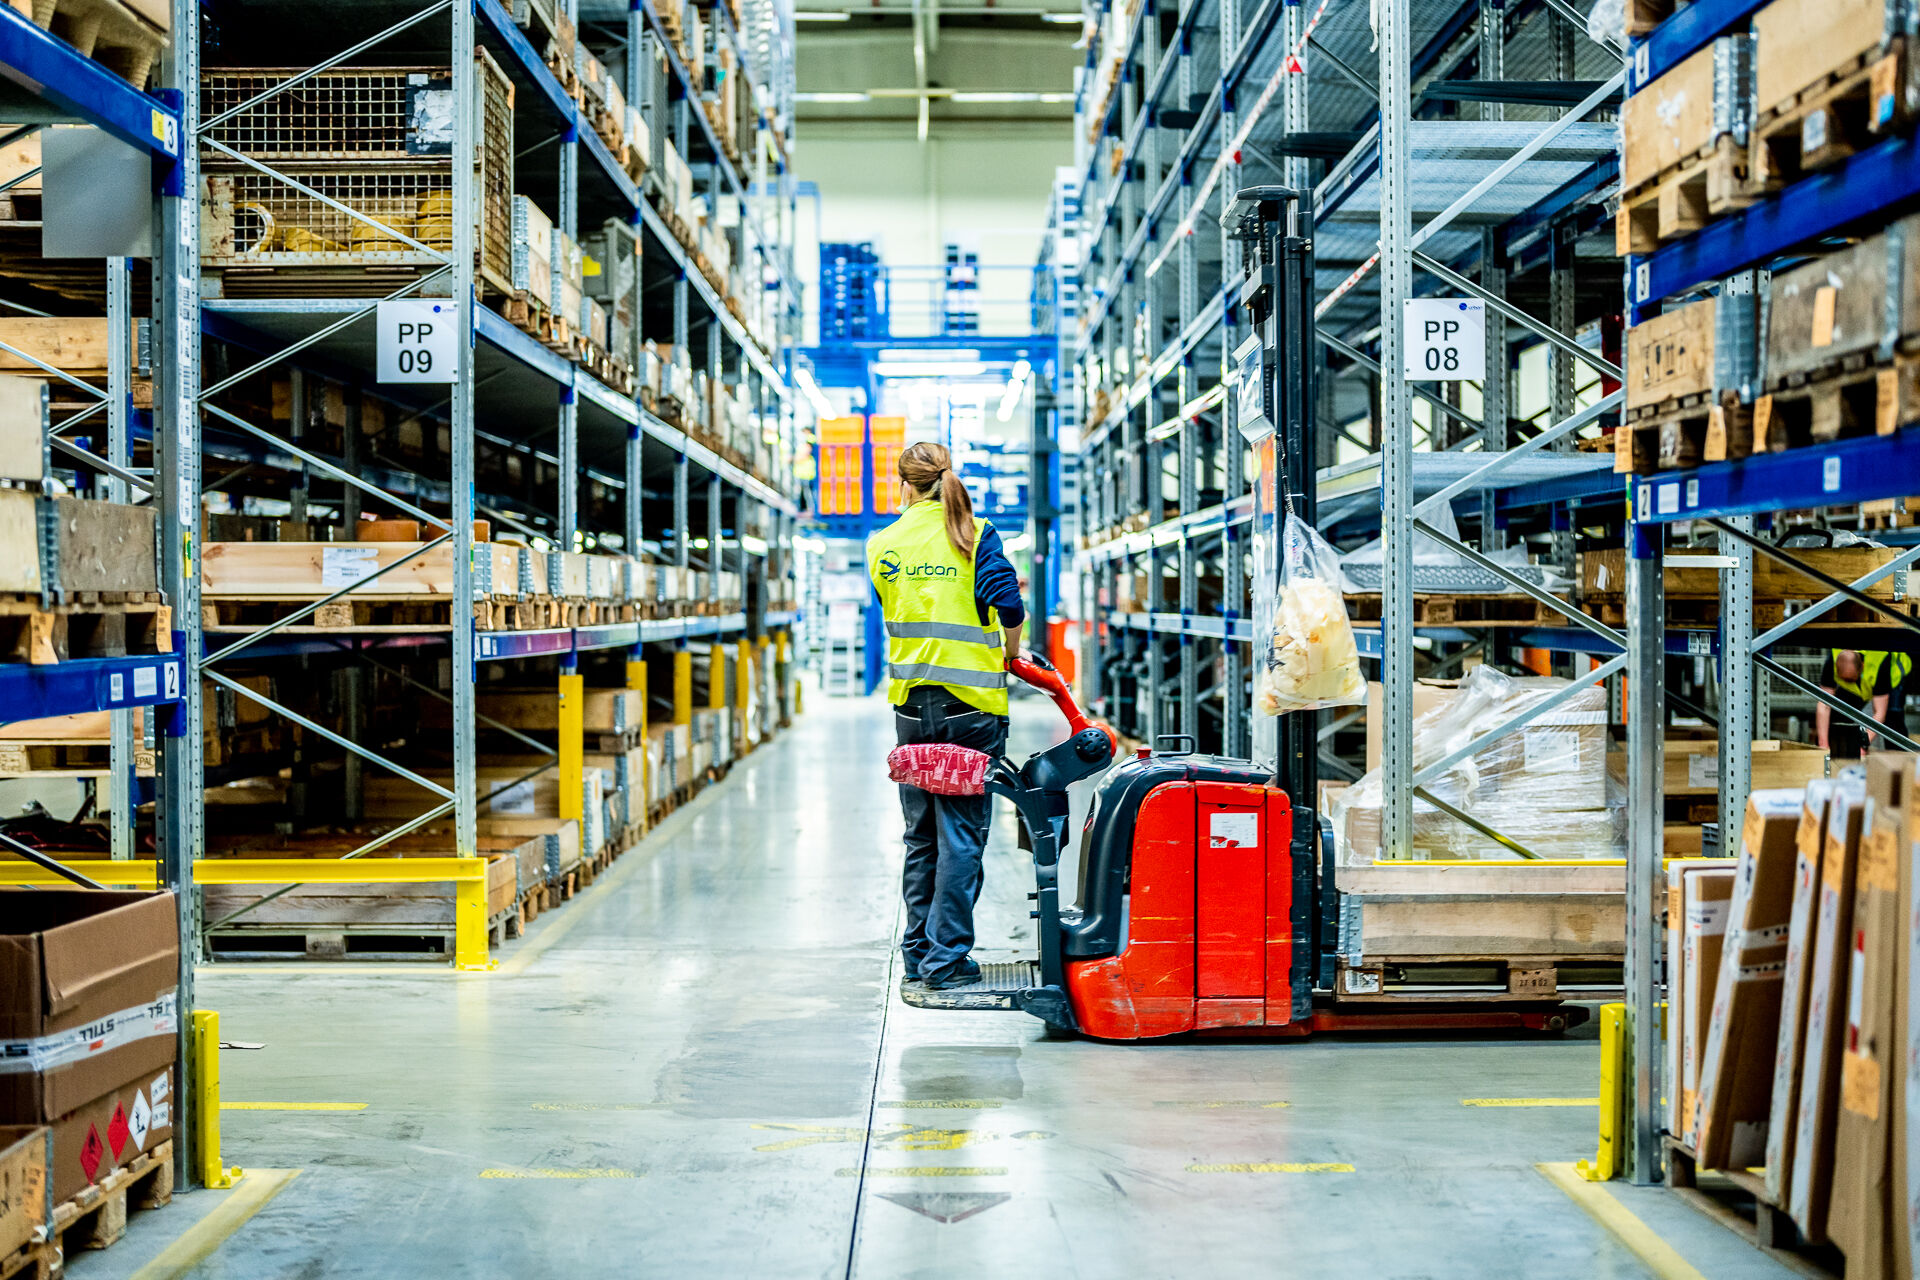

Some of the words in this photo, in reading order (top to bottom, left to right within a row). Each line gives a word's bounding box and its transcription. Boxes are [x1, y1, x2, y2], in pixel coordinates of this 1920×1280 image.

[167, 120, 175, 149] 3
[398, 323, 433, 344] PP
[1425, 320, 1460, 341] PP
[398, 349, 433, 374] 09
[1425, 347, 1459, 371] 08
[1641, 488, 1648, 517] 2
[905, 562, 957, 577] urban
[168, 665, 176, 695] 2
[78, 1018, 116, 1042] STILL
